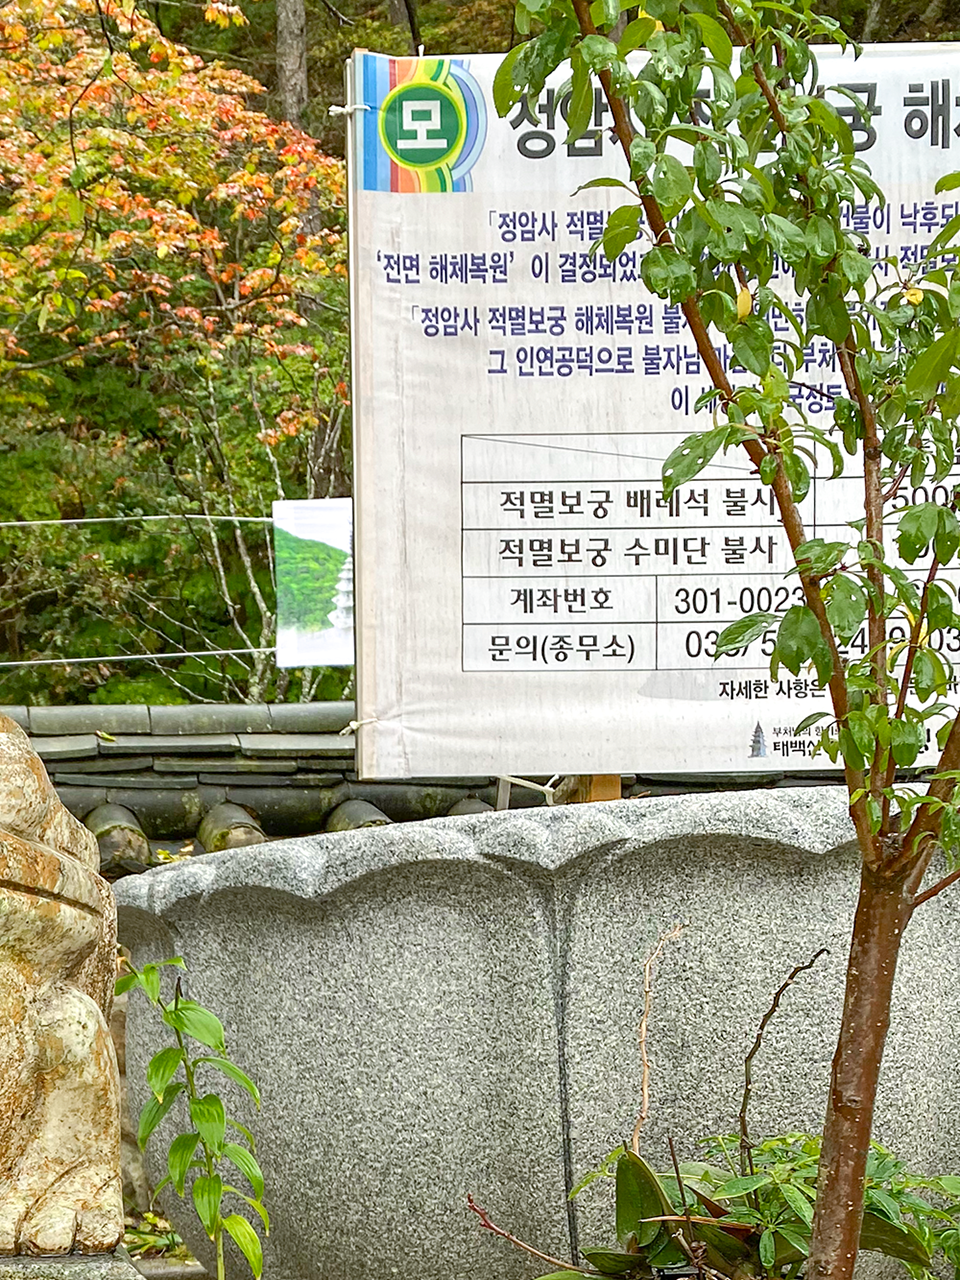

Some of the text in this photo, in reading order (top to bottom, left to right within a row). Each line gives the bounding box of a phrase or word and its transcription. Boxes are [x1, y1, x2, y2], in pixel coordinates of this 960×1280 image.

[396, 99, 448, 149] 모
[903, 79, 960, 150] 해
[531, 253, 550, 283] 이
[558, 250, 643, 283] 결정되었
[488, 305, 567, 336] 적멸보궁
[575, 303, 654, 335] 해체복원
[487, 349, 508, 374] 그
[516, 346, 635, 377] 인연공덕으로
[642, 345, 701, 376] 불자님
[671, 385, 689, 416] 이
[499, 489, 615, 520] 적멸보궁
[722, 488, 777, 517] 불사
[498, 535, 778, 568] 적멸보궁 수미단 불사
[509, 587, 615, 615] 계좌번호
[487, 634, 636, 664] 문의(종무소)
[718, 680, 769, 700] 자세한
